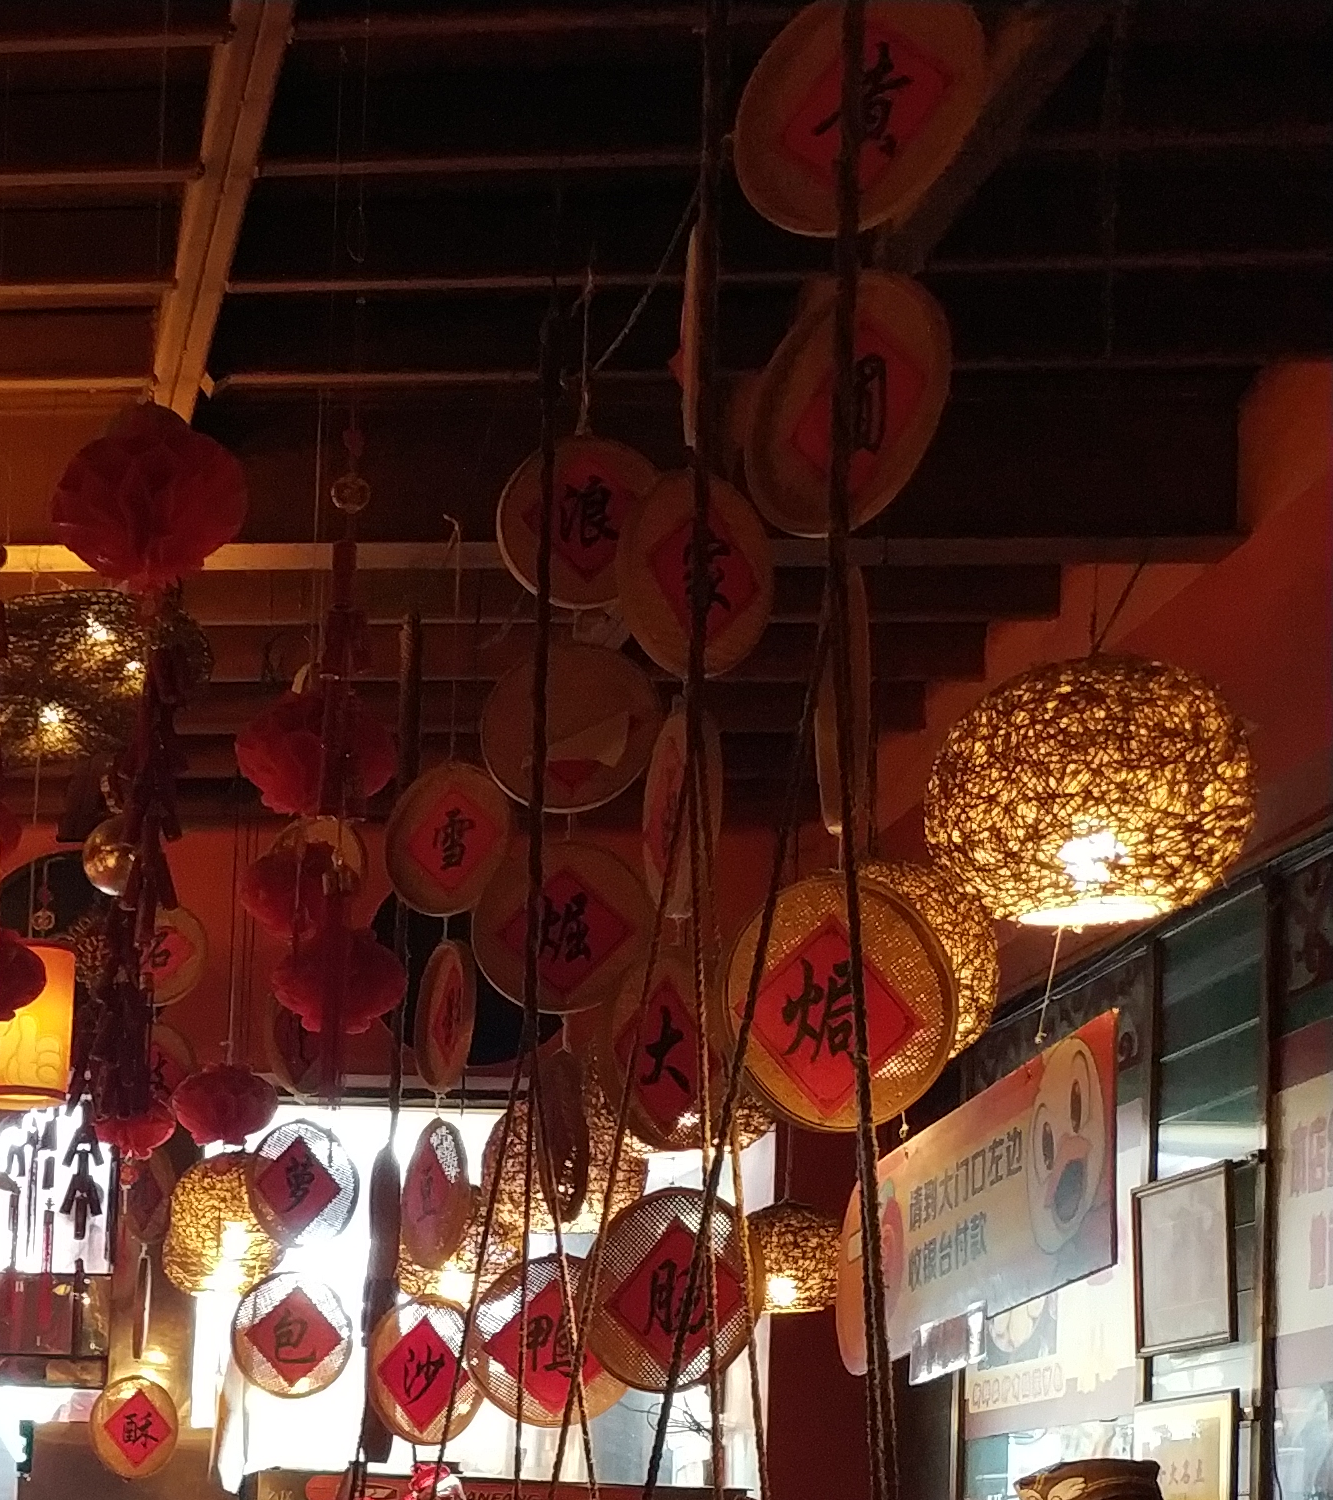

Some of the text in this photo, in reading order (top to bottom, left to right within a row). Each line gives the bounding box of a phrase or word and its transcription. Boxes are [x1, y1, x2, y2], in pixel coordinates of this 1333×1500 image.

[432, 810, 476, 870] 雪
[641, 1006, 690, 1092] 大
[909, 1126, 1023, 1232] 请到大门口左边
[908, 1211, 987, 1292] 收银台付款
[273, 1312, 318, 1364] 包
[123, 1412, 159, 1448] 酥
